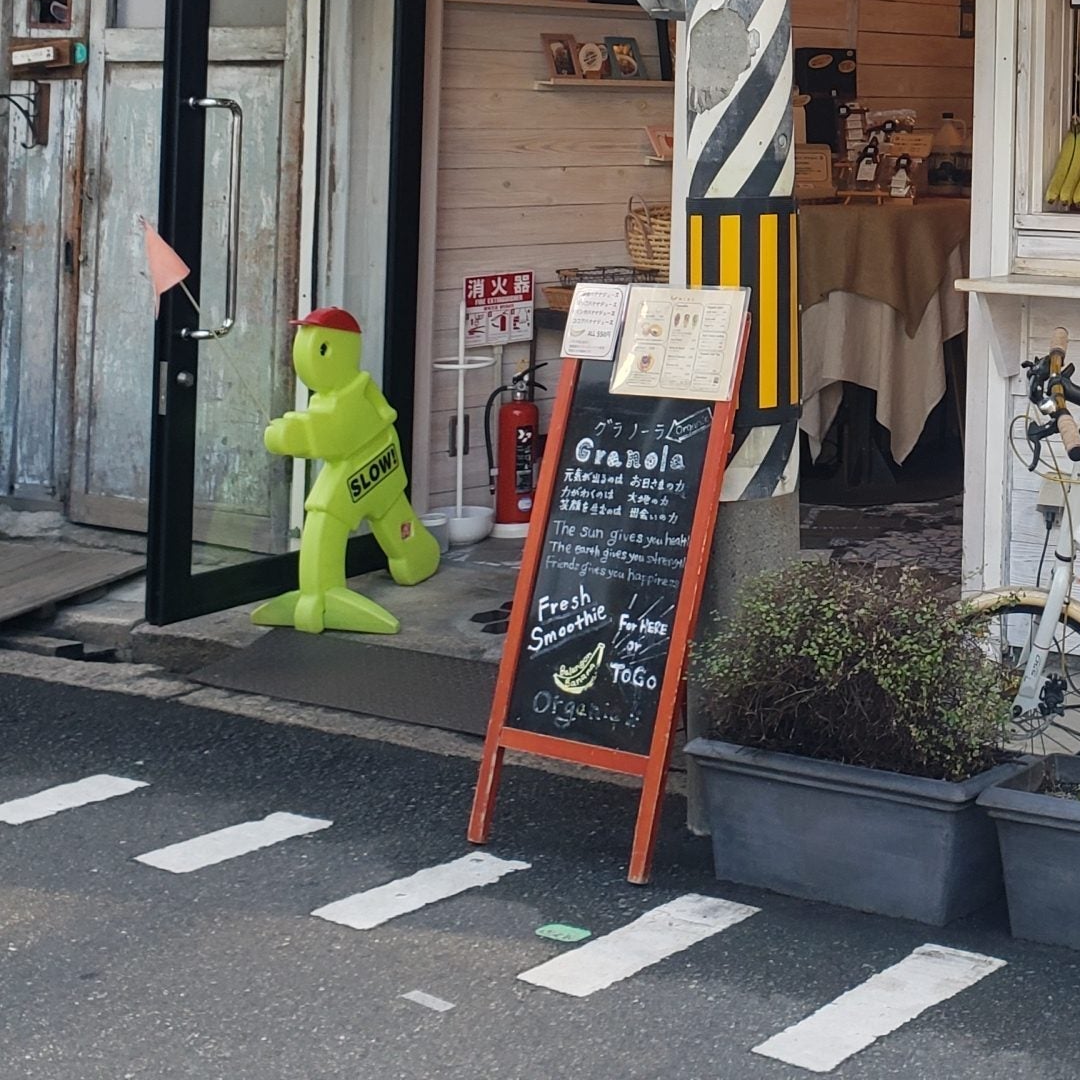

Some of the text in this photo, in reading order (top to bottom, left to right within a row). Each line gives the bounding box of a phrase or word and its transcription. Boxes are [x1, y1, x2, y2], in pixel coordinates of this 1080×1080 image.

[468, 274, 530, 298] 消火器
[594, 419, 665, 440] グラノーラ
[575, 437, 686, 472] Granola
[351, 449, 396, 497] SLOW!
[553, 520, 576, 536] The
[579, 526, 604, 539] sun
[607, 529, 643, 546] gives
[643, 534, 663, 548] you
[549, 541, 571, 554] The
[574, 545, 600, 558] earth
[600, 548, 626, 563] gives
[625, 552, 645, 564] you
[579, 561, 606, 577] gives
[606, 568, 625, 579] you
[538, 584, 591, 622] Fresh
[528, 605, 607, 651] Smoothie
[619, 614, 668, 635] For HERE
